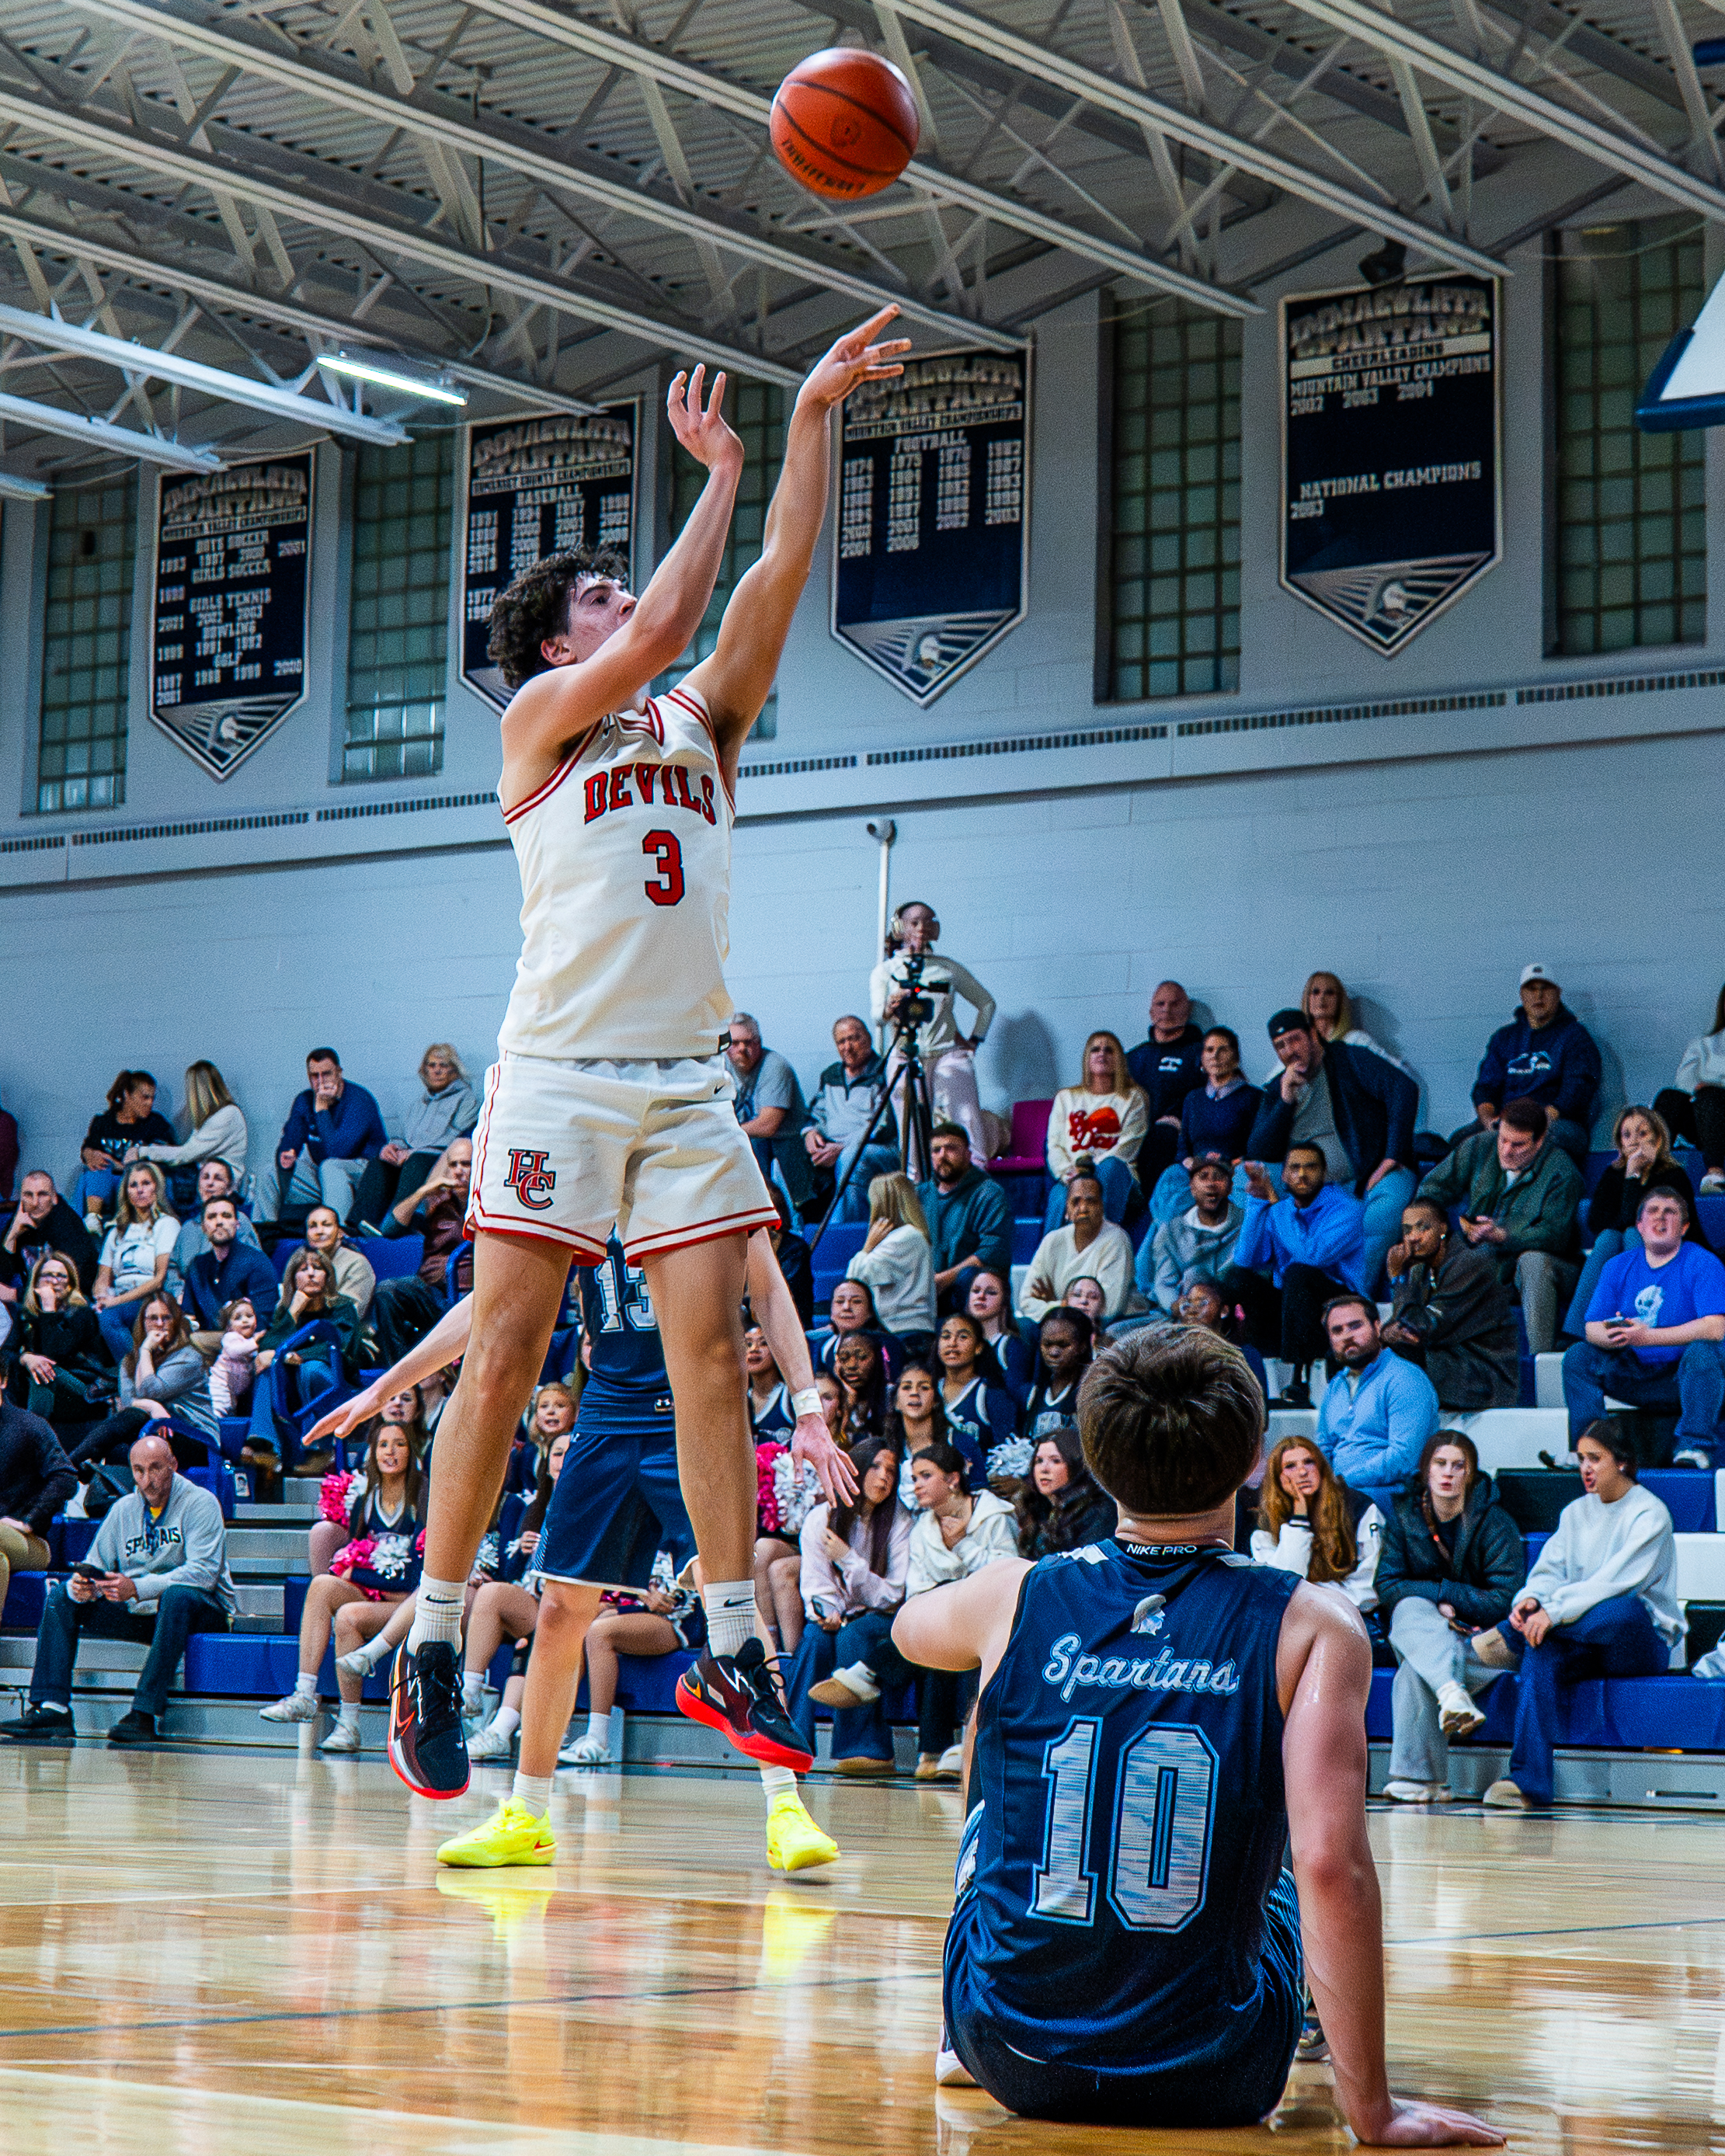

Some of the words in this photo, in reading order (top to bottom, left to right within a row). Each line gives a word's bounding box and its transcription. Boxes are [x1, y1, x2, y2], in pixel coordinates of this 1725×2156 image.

[1362, 365, 1410, 387] VALLEY
[1414, 354, 1490, 381] CHAMPIONS
[894, 430, 967, 454] FOOTBALL
[516, 484, 583, 507] BASEBALL
[1299, 473, 1380, 500] NATIONAL
[1383, 460, 1481, 489] CHAMPIONS
[196, 536, 224, 554] BOYS
[228, 530, 269, 549] SOCCER
[192, 565, 224, 583] GIRLS
[228, 558, 271, 579] SOCCER
[190, 594, 222, 614] GIRLS
[226, 587, 271, 608] TENNIS
[203, 619, 256, 641] BOWLING
[213, 650, 243, 669] GOLF
[583, 763, 717, 826] DEVILS
[642, 829, 685, 906] 3
[503, 1148, 557, 1211] HC
[594, 1256, 659, 1334] 13
[126, 1527, 181, 1558] SPAS
[1126, 1543, 1161, 1556] NIKE
[1162, 1544, 1198, 1556] PRO
[1042, 1632, 1240, 1702] Spartans
[1026, 1715, 1220, 1935] 10
